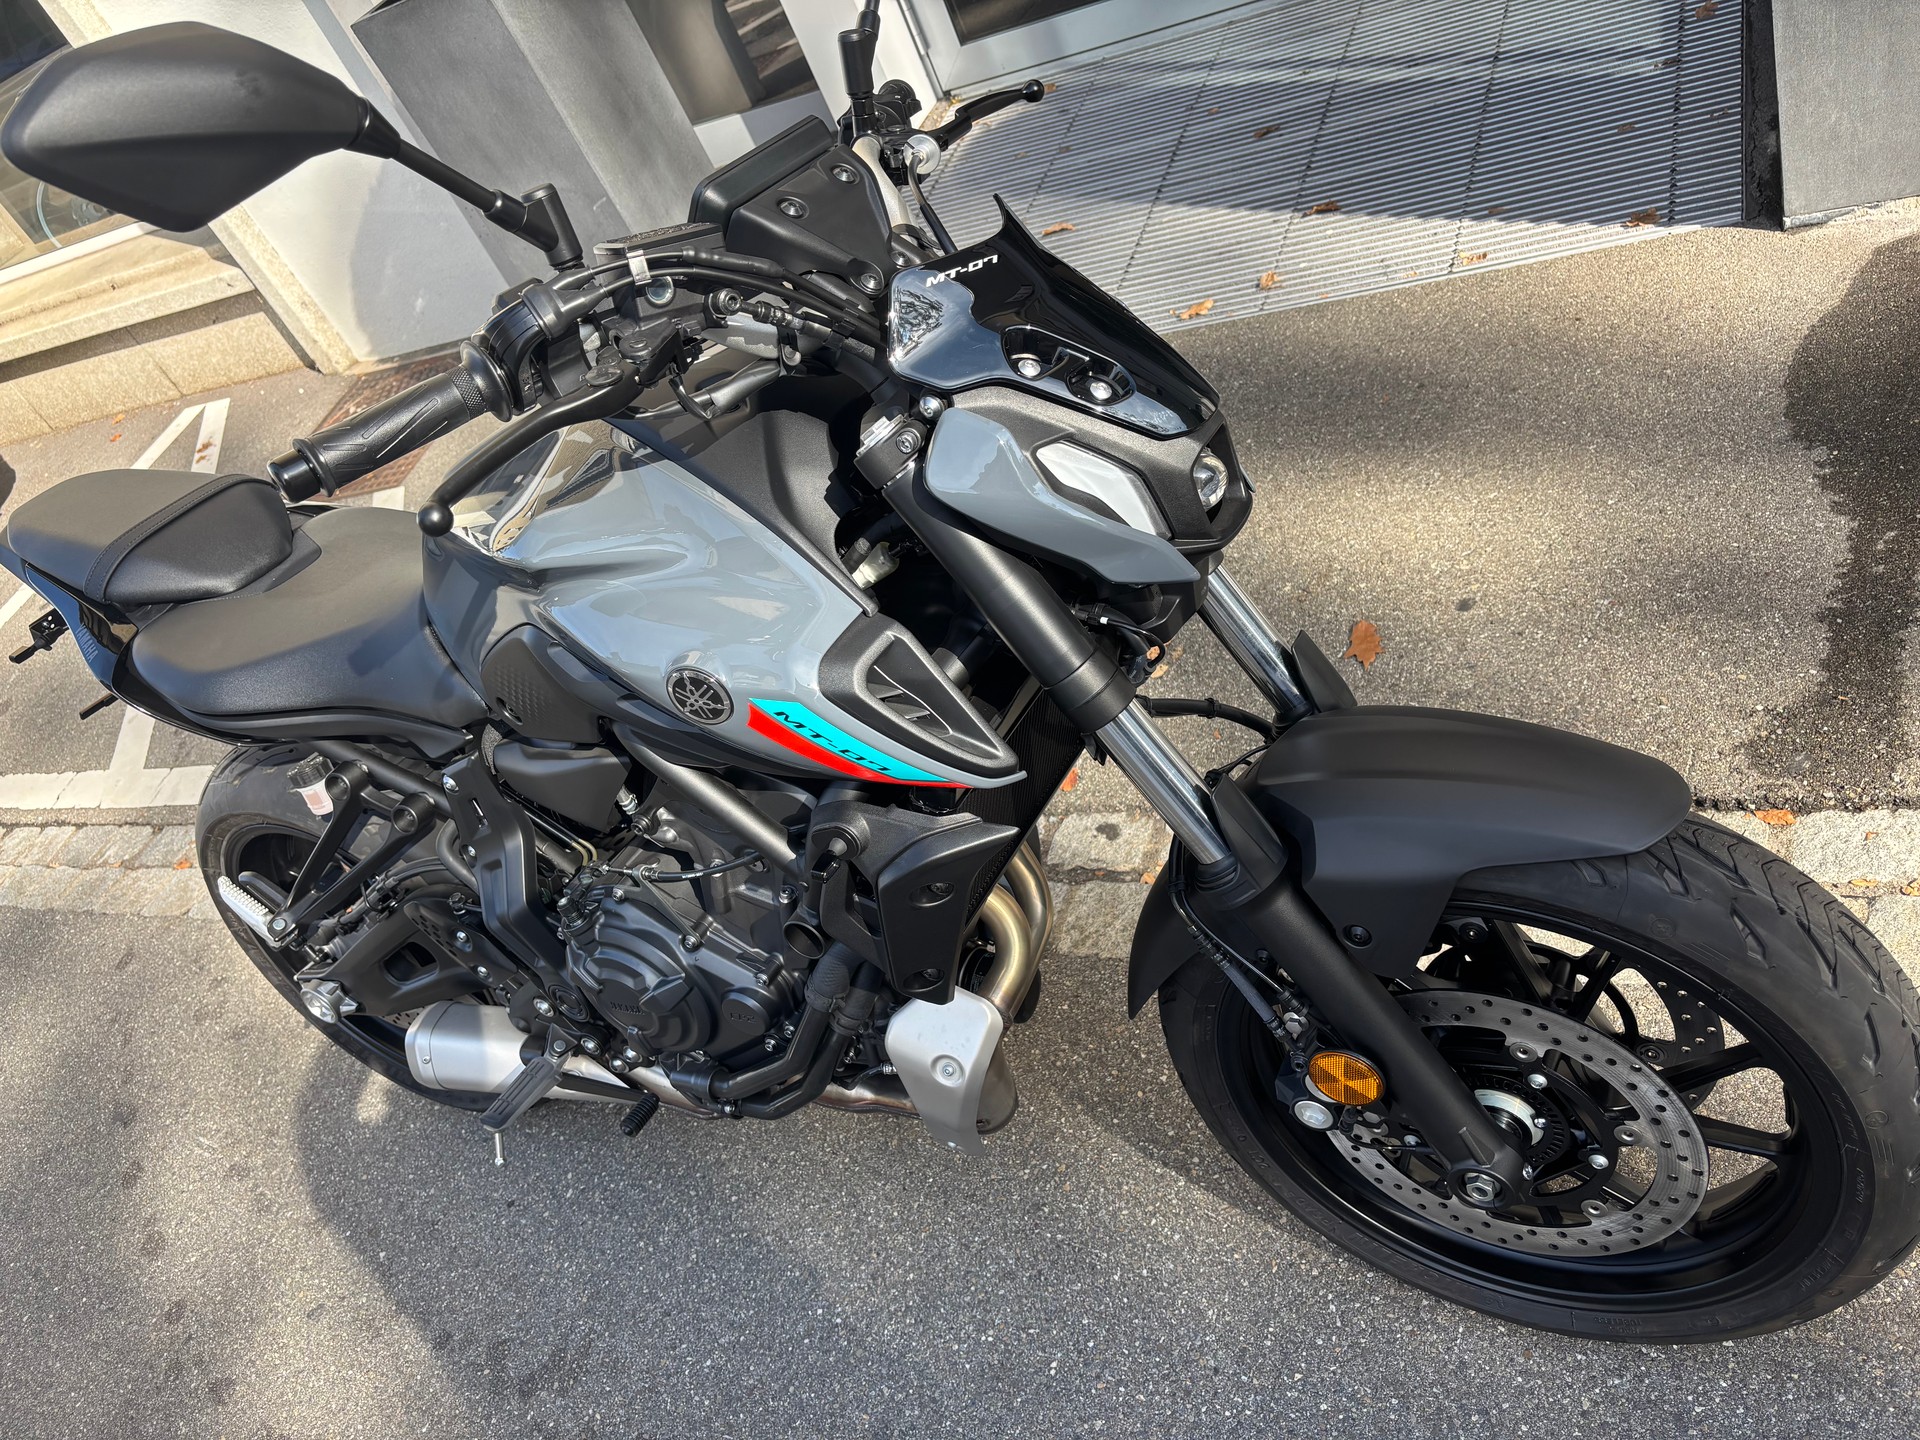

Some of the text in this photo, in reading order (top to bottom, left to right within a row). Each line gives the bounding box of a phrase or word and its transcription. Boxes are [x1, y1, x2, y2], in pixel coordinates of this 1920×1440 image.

[926, 254, 998, 288] MT-07
[75, 622, 99, 663] YAMAHA
[773, 711, 892, 773] MT-07
